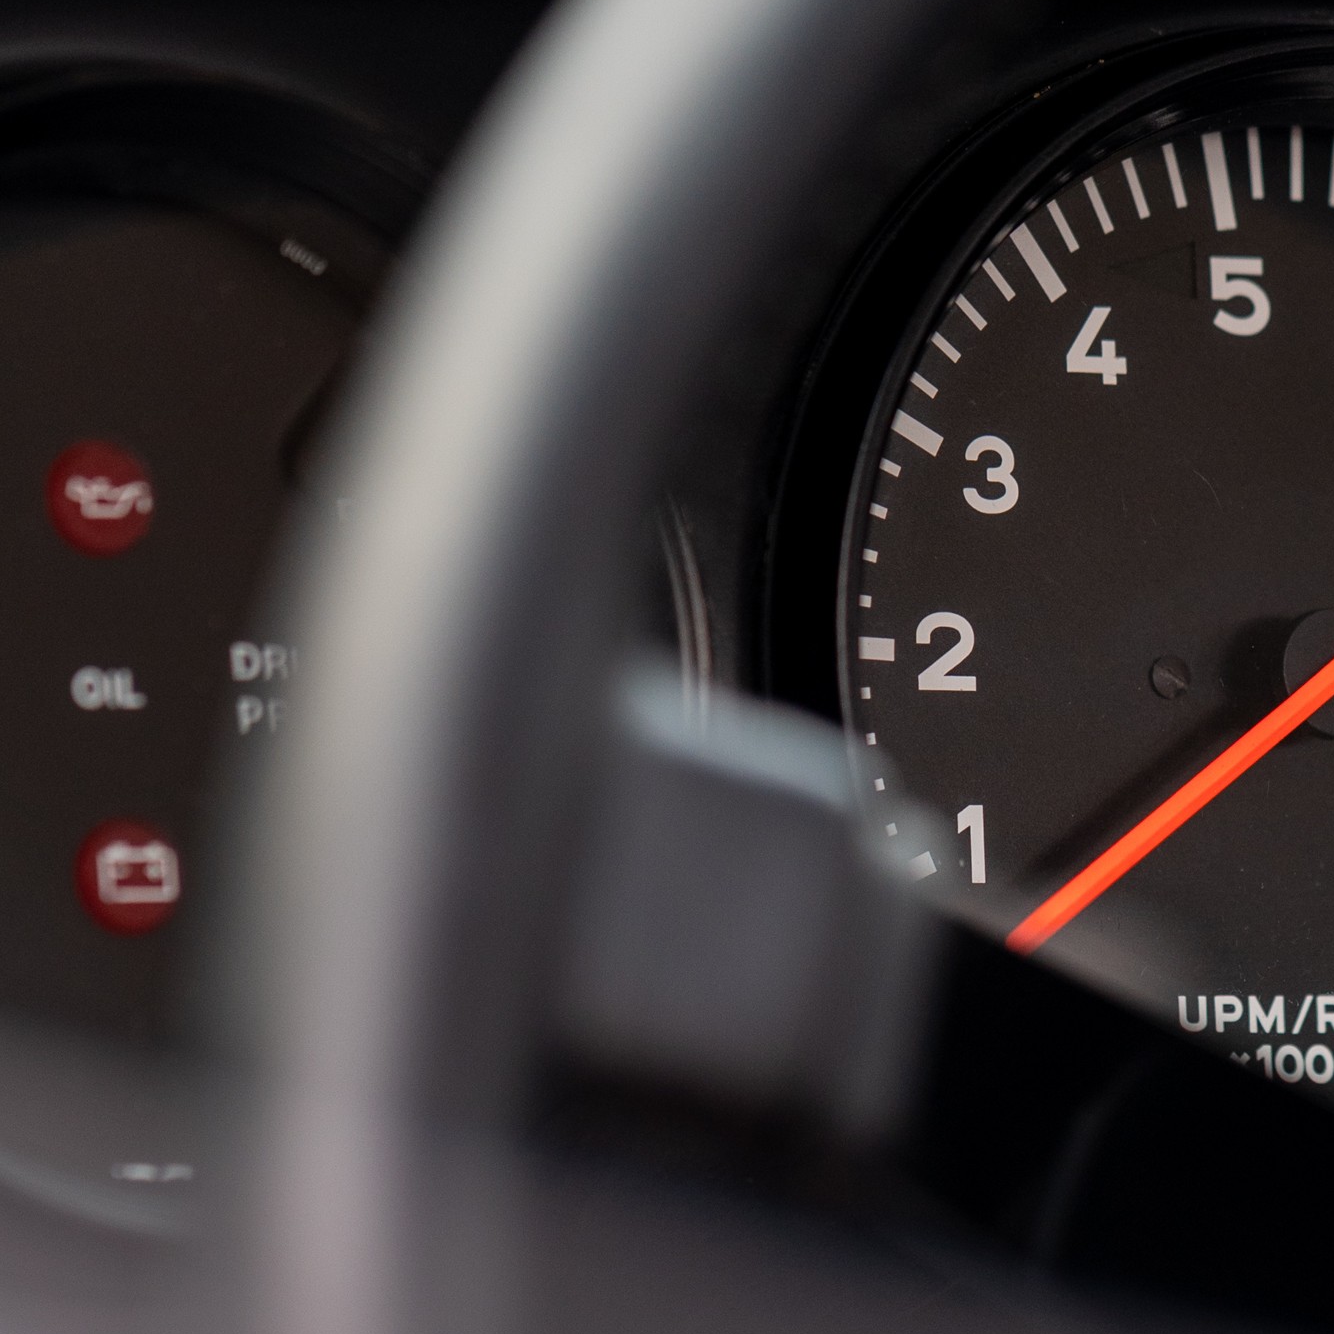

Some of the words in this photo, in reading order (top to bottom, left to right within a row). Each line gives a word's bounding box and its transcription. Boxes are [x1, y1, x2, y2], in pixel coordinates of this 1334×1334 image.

[1209, 256, 1271, 337] 5
[1066, 306, 1127, 385] 4
[962, 435, 1020, 514] 3
[70, 666, 148, 710] OIL
[915, 611, 977, 692] 2
[956, 804, 987, 884] 1
